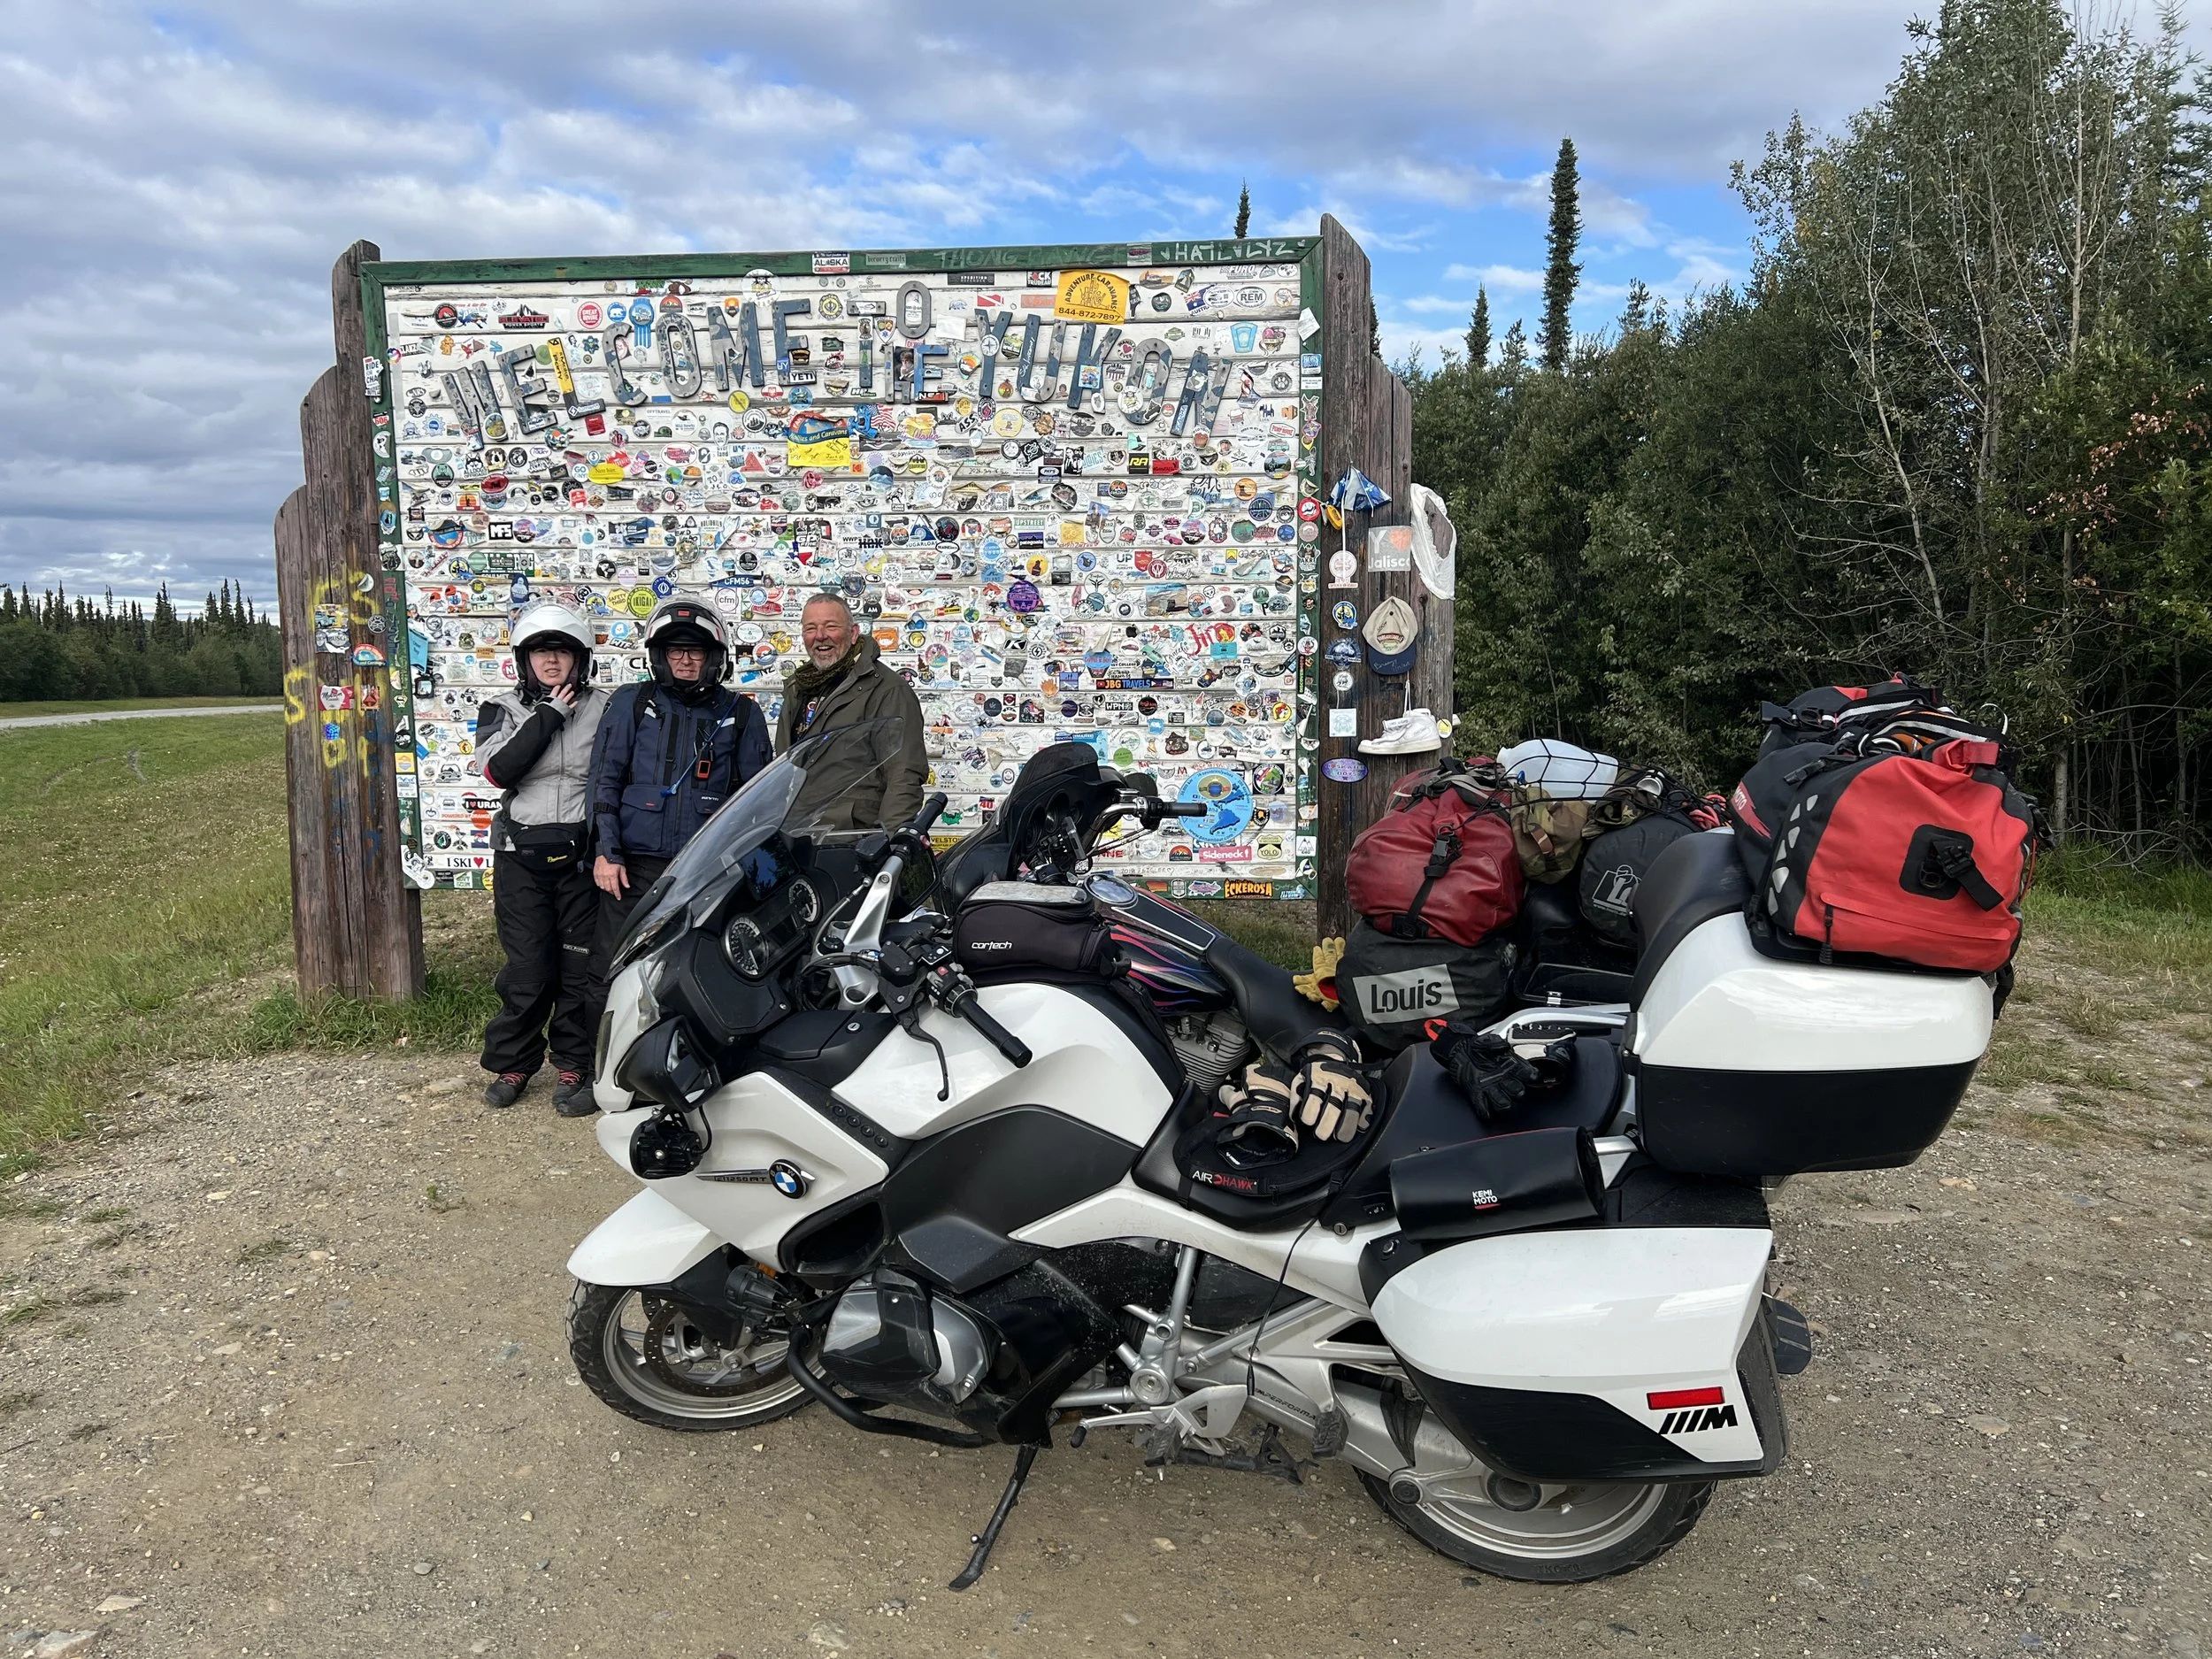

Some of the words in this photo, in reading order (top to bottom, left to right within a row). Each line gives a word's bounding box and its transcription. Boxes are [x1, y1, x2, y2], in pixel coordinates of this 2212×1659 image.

[1064, 273, 1094, 303] ADVENTURE
[1096, 274, 1118, 310] CARAVANS
[1240, 293, 1263, 302] REM
[1058, 306, 1121, 322] 844-872-7897
[441, 297, 811, 449] WELCOME
[974, 308, 1232, 435] YUKON
[958, 414, 976, 432] ASS
[808, 433, 820, 442] and
[821, 428, 848, 439] Caravans
[913, 427, 941, 441] Alaska
[1129, 457, 1148, 466] RA
[1116, 553, 1133, 563] UP
[609, 593, 626, 602] SAFETY
[633, 595, 653, 607] IKIGAI
[719, 595, 735, 604] cfm
[1104, 679, 1122, 688] JBG
[1122, 679, 1151, 688] TRAVELS
[1202, 850, 1243, 859] Sideneck
[453, 857, 472, 868] SKI
[1225, 879, 1272, 898] ECKEROSA
[972, 941, 1012, 950] cortech
[1371, 979, 1442, 1015] Louis
[769, 1164, 795, 1176] BMW
[1472, 1188, 1493, 1199] KEMI
[1473, 1195, 1498, 1206] MOTO
